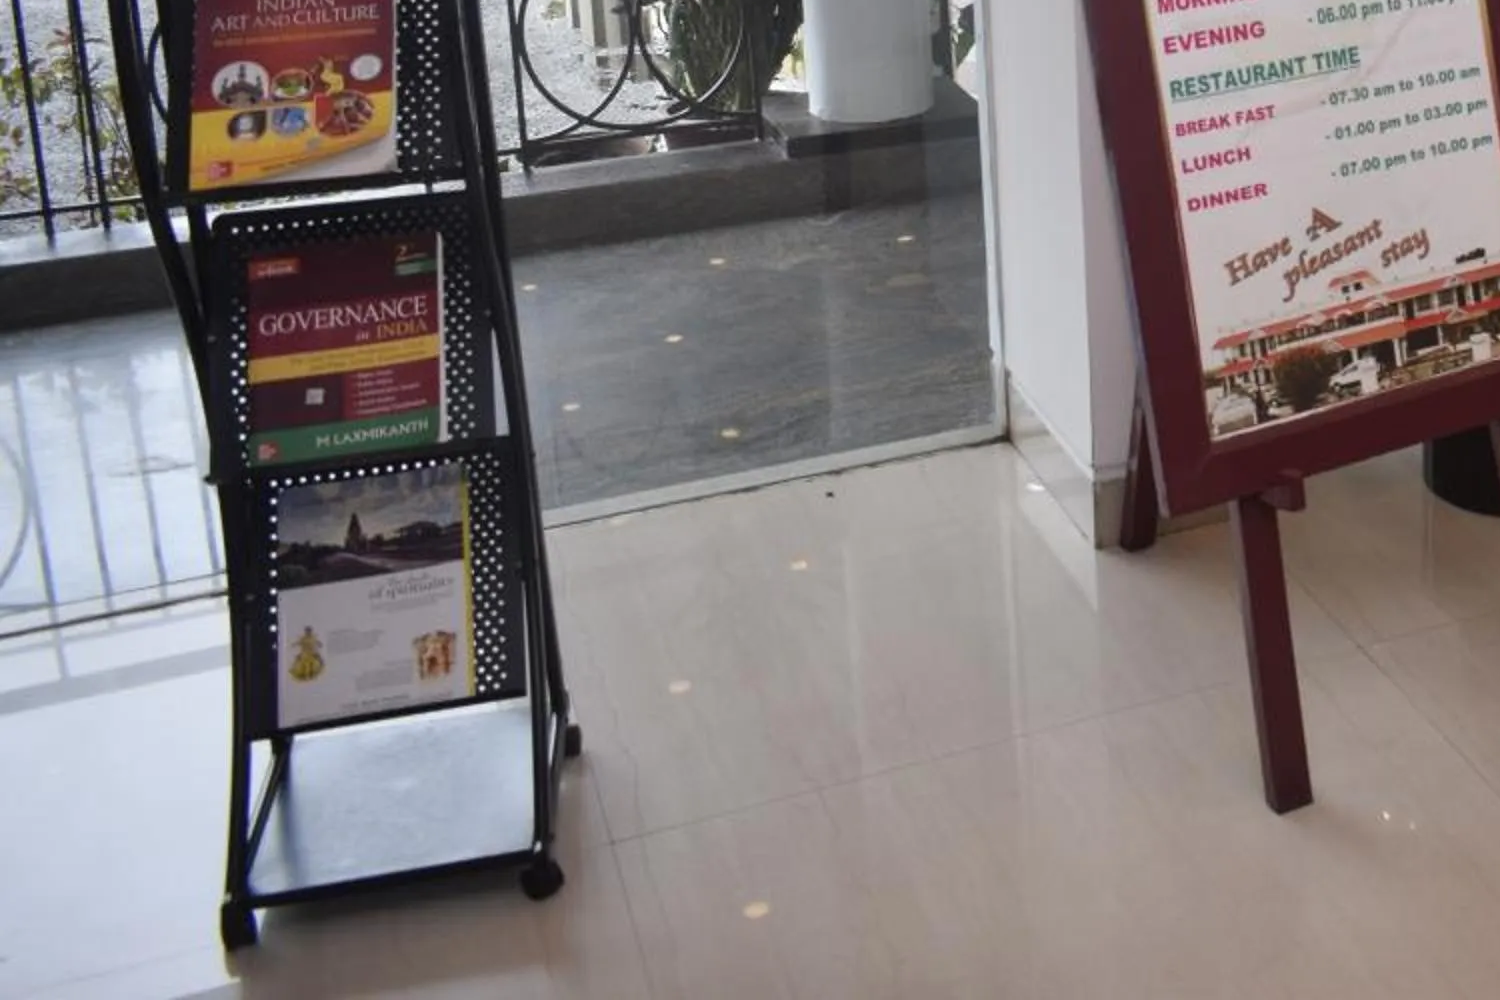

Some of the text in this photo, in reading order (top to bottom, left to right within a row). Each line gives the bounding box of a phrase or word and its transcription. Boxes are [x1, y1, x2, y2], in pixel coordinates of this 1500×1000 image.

[210, 3, 380, 34] ART AND CULTURE
[1316, 2, 1358, 25] 06.00
[1361, 0, 1385, 21] pm
[1163, 20, 1266, 55] EVENING
[1169, 46, 1361, 99] RESTAURANT TIME
[1328, 86, 1369, 107] 07.30
[1374, 83, 1396, 98] am
[1399, 76, 1414, 92] to
[1418, 68, 1456, 89] 10.00
[1459, 65, 1481, 80] am
[1175, 105, 1276, 138] BREAK FAST
[1335, 120, 1375, 141] 01.00
[1379, 117, 1401, 136] pm
[1405, 110, 1420, 126] to
[1424, 102, 1464, 123] 03.00
[1467, 98, 1489, 117] pm
[1181, 147, 1252, 175] LUNCH
[1340, 157, 1382, 178] 07.00
[1385, 152, 1408, 171] pm
[1410, 146, 1426, 162] to
[1430, 138, 1469, 159] 10.00
[1472, 133, 1494, 152] pm
[1187, 183, 1268, 213] DINNER
[1223, 207, 1343, 288] Have A
[1282, 218, 1384, 303] pleasant
[1381, 228, 1431, 269] stay
[258, 295, 428, 337] GOVERNANCE
[376, 319, 428, 340] INDIA
